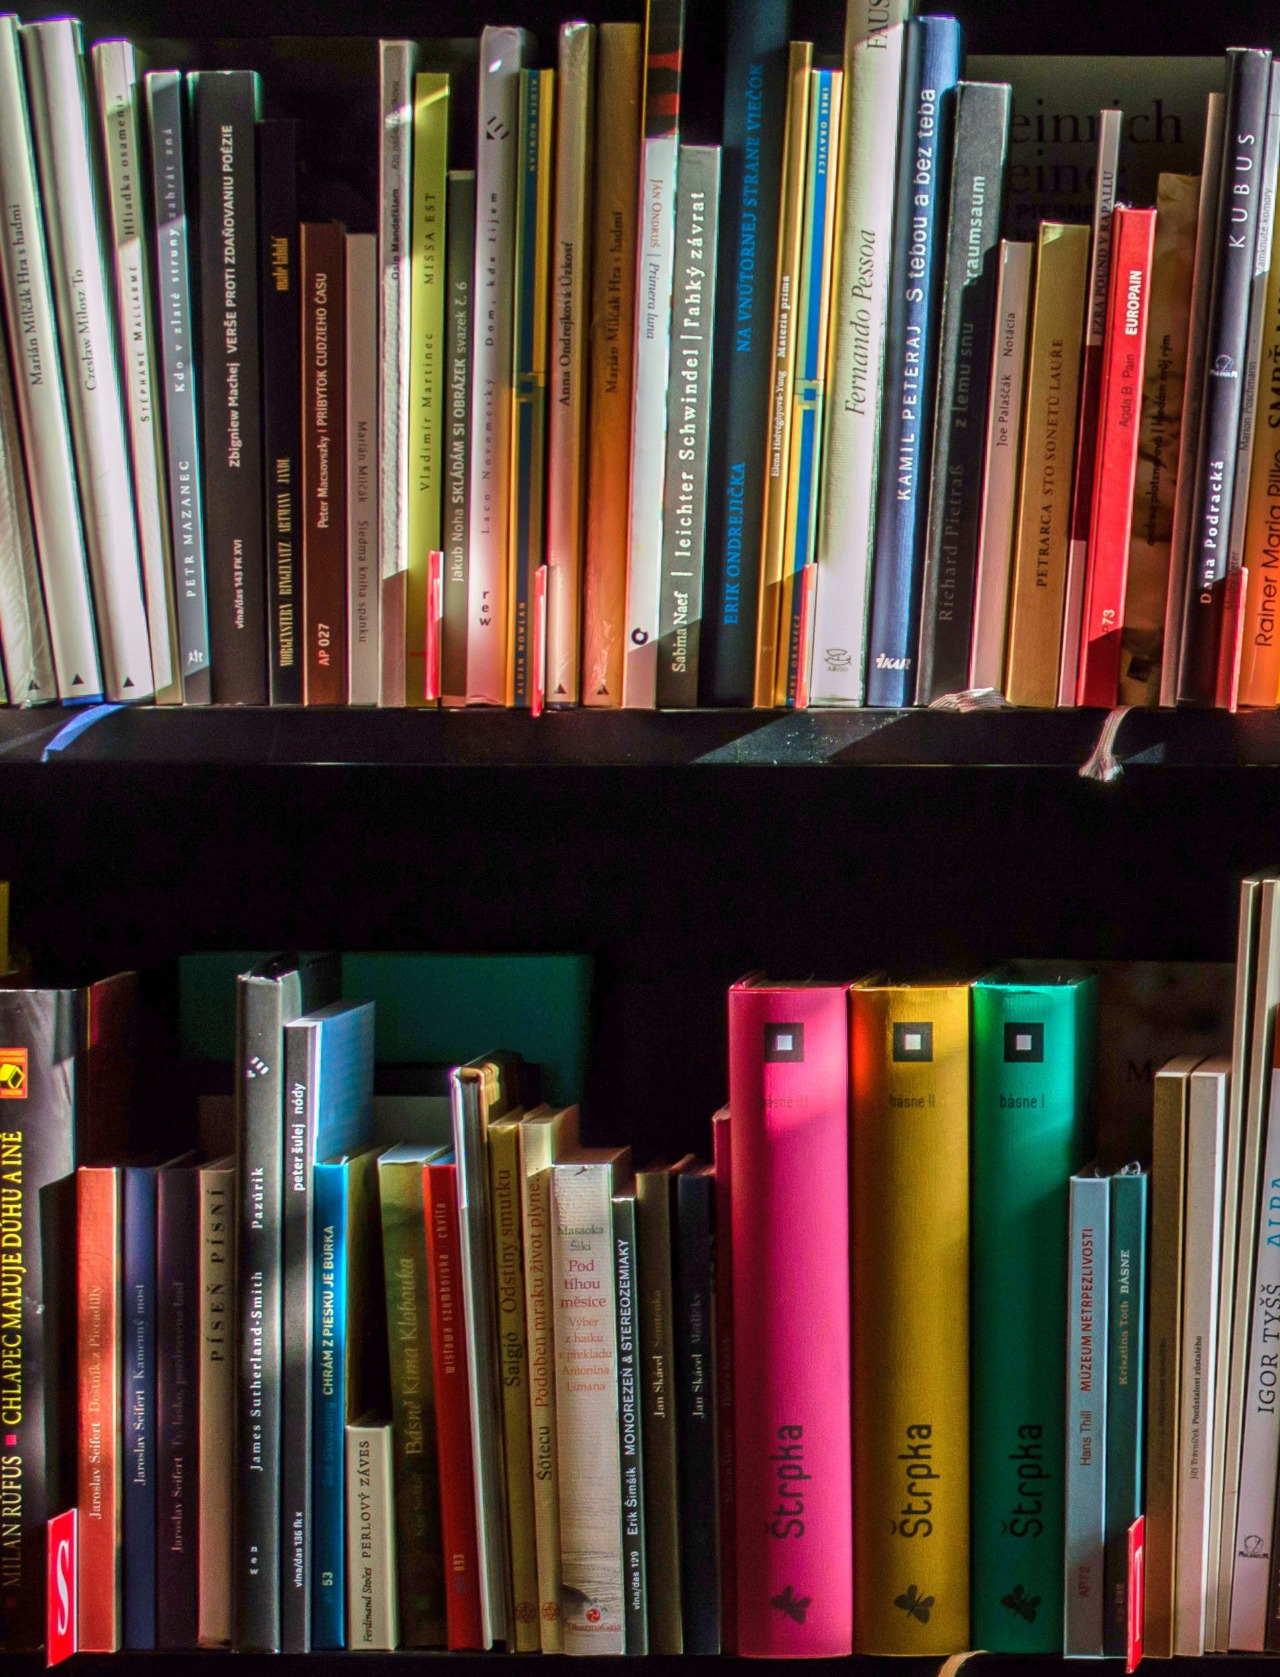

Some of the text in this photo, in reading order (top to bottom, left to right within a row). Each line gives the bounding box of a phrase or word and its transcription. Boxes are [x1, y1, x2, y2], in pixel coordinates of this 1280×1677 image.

[220, 125, 238, 353] VERŠE PROTI ZDAŇOVANIU POÉZIE
[1229, 134, 1255, 248] KUBUS
[313, 273, 328, 426] PRÍBYTOK CUDZIEHO ČASU
[845, 230, 876, 415] Fernando Pessoa
[897, 89, 935, 500] KAMIL PETERAJ S tebou a bez teba
[1124, 270, 1143, 335] EUROPAIN
[226, 363, 243, 467] Zbigniew Machej
[179, 461, 197, 597] PETR MAZANEC
[724, 463, 746, 624] ERIK ONDREJIČKA
[318, 624, 330, 665] AP 027
[1255, 576, 1278, 646] Rainer
[2, 1169, 21, 1183] A
[206, 1190, 223, 1361] PÍSEŇ PÍSNÍ
[249, 1168, 264, 1471] James Sutherland-Smith Pazúrik
[322, 1272, 335, 1286] JE
[322, 1292, 335, 1335] PIESKU
[617, 1239, 634, 1350] STEREOZEMIAKY
[2, 1335, 22, 1424] CHLAPEC
[322, 1350, 334, 1395] CHRÁM
[622, 1355, 634, 1363] &
[1079, 1228, 1093, 1466] Hans Thill MÚZEUM NETRPEZLIVOSTI
[1257, 1354, 1279, 1414] IGOR
[620, 1368, 636, 1454] MONOREZEŇ
[625, 1511, 639, 1535] Erik
[765, 1424, 812, 1539] Štrpka
[892, 1424, 939, 1538] Štrpka
[1008, 1424, 1051, 1538] Štrpka
